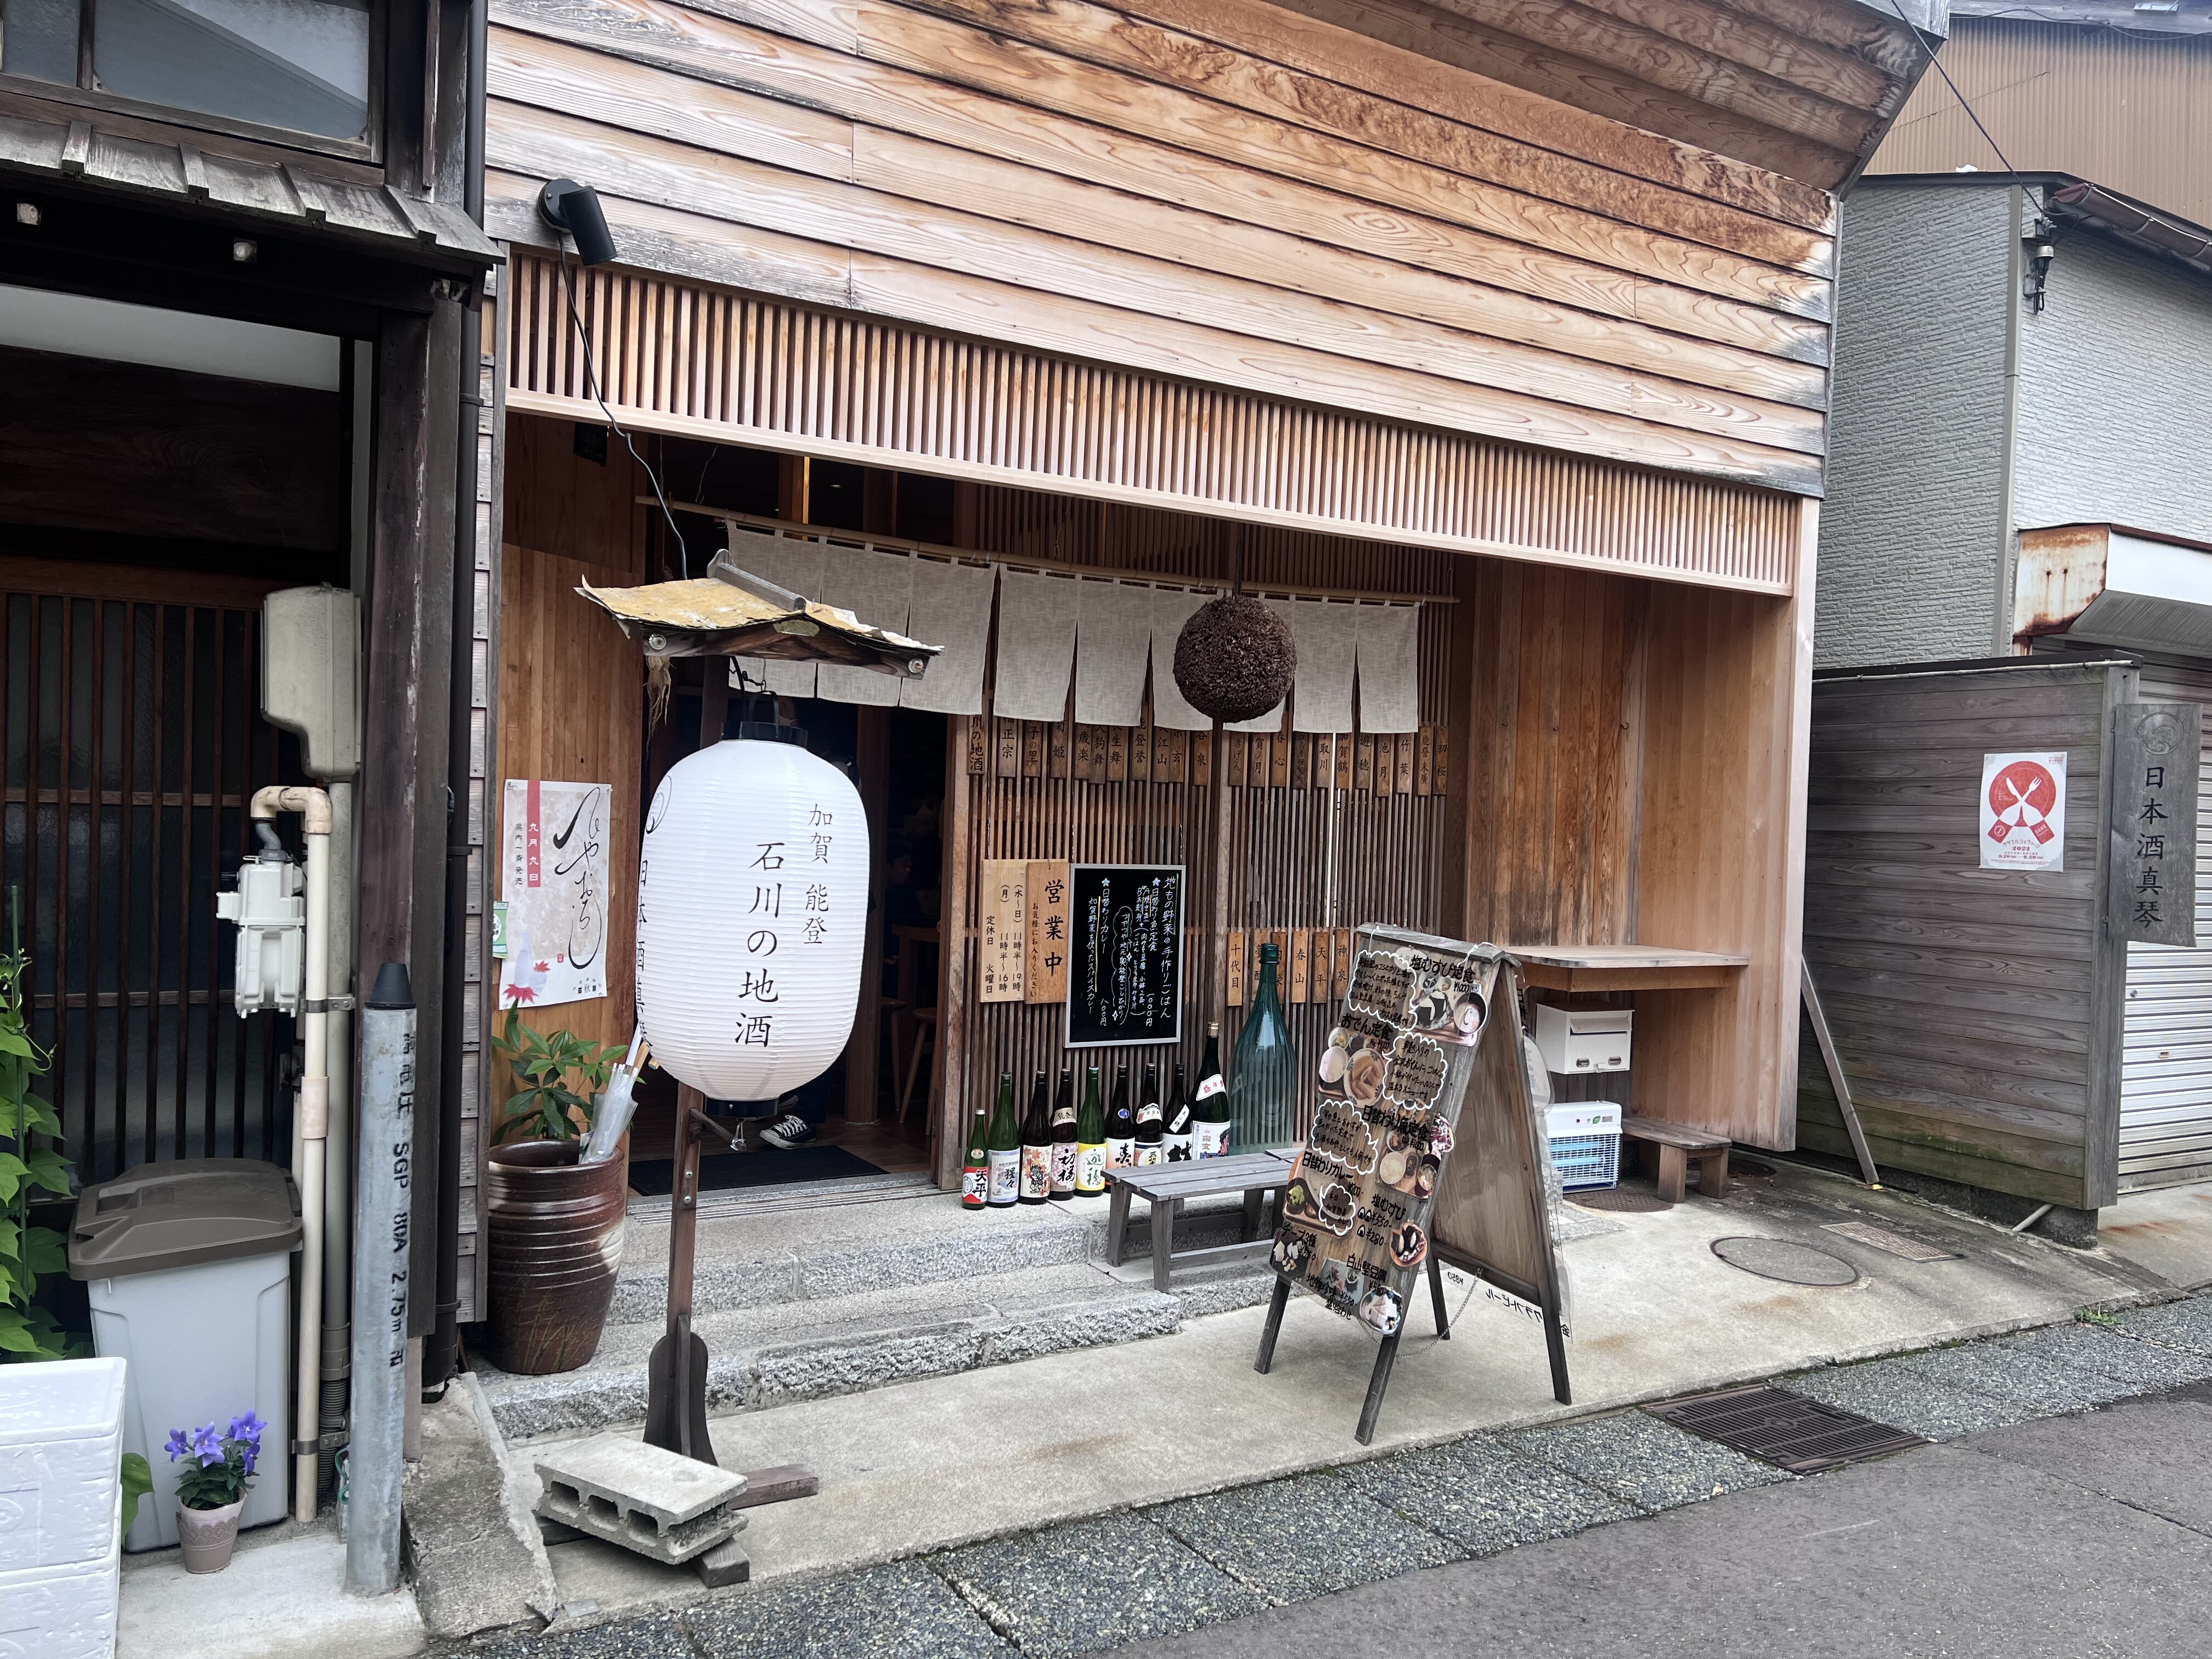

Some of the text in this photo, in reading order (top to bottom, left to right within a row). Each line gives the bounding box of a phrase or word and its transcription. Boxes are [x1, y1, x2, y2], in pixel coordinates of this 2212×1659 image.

[1026, 720, 1040, 763] 子の里
[1077, 724, 1090, 762] 歳楽
[1234, 733, 1242, 771] きげん
[1379, 742, 1389, 778] 池月
[1400, 740, 1410, 776] 竹葉
[528, 823, 539, 881] 九月九日
[2133, 766, 2168, 928] 日本酒真琴
[735, 842, 785, 1048] 石川の地酒
[1044, 879, 1064, 977] 営業中
[985, 915, 995, 994] 定休日 火曜日
[1030, 902, 1039, 997] お気軽にお入りください
[1230, 944, 1241, 989] 十代目
[1295, 947, 1306, 984] 春山
[1316, 946, 1327, 986] 天平
[1337, 945, 1347, 982] 神泉
[1410, 954, 1476, 984] 塩むすび定食
[1341, 1013, 1394, 1041] おでん定食
[393, 1142, 409, 1189] SGP
[972, 1169, 987, 1197] 天平
[1302, 1151, 1354, 1180] 日替わりカレー
[1371, 1193, 1407, 1221] 塩むすび
[1346, 1253, 1387, 1283] 白山堅豆腐
